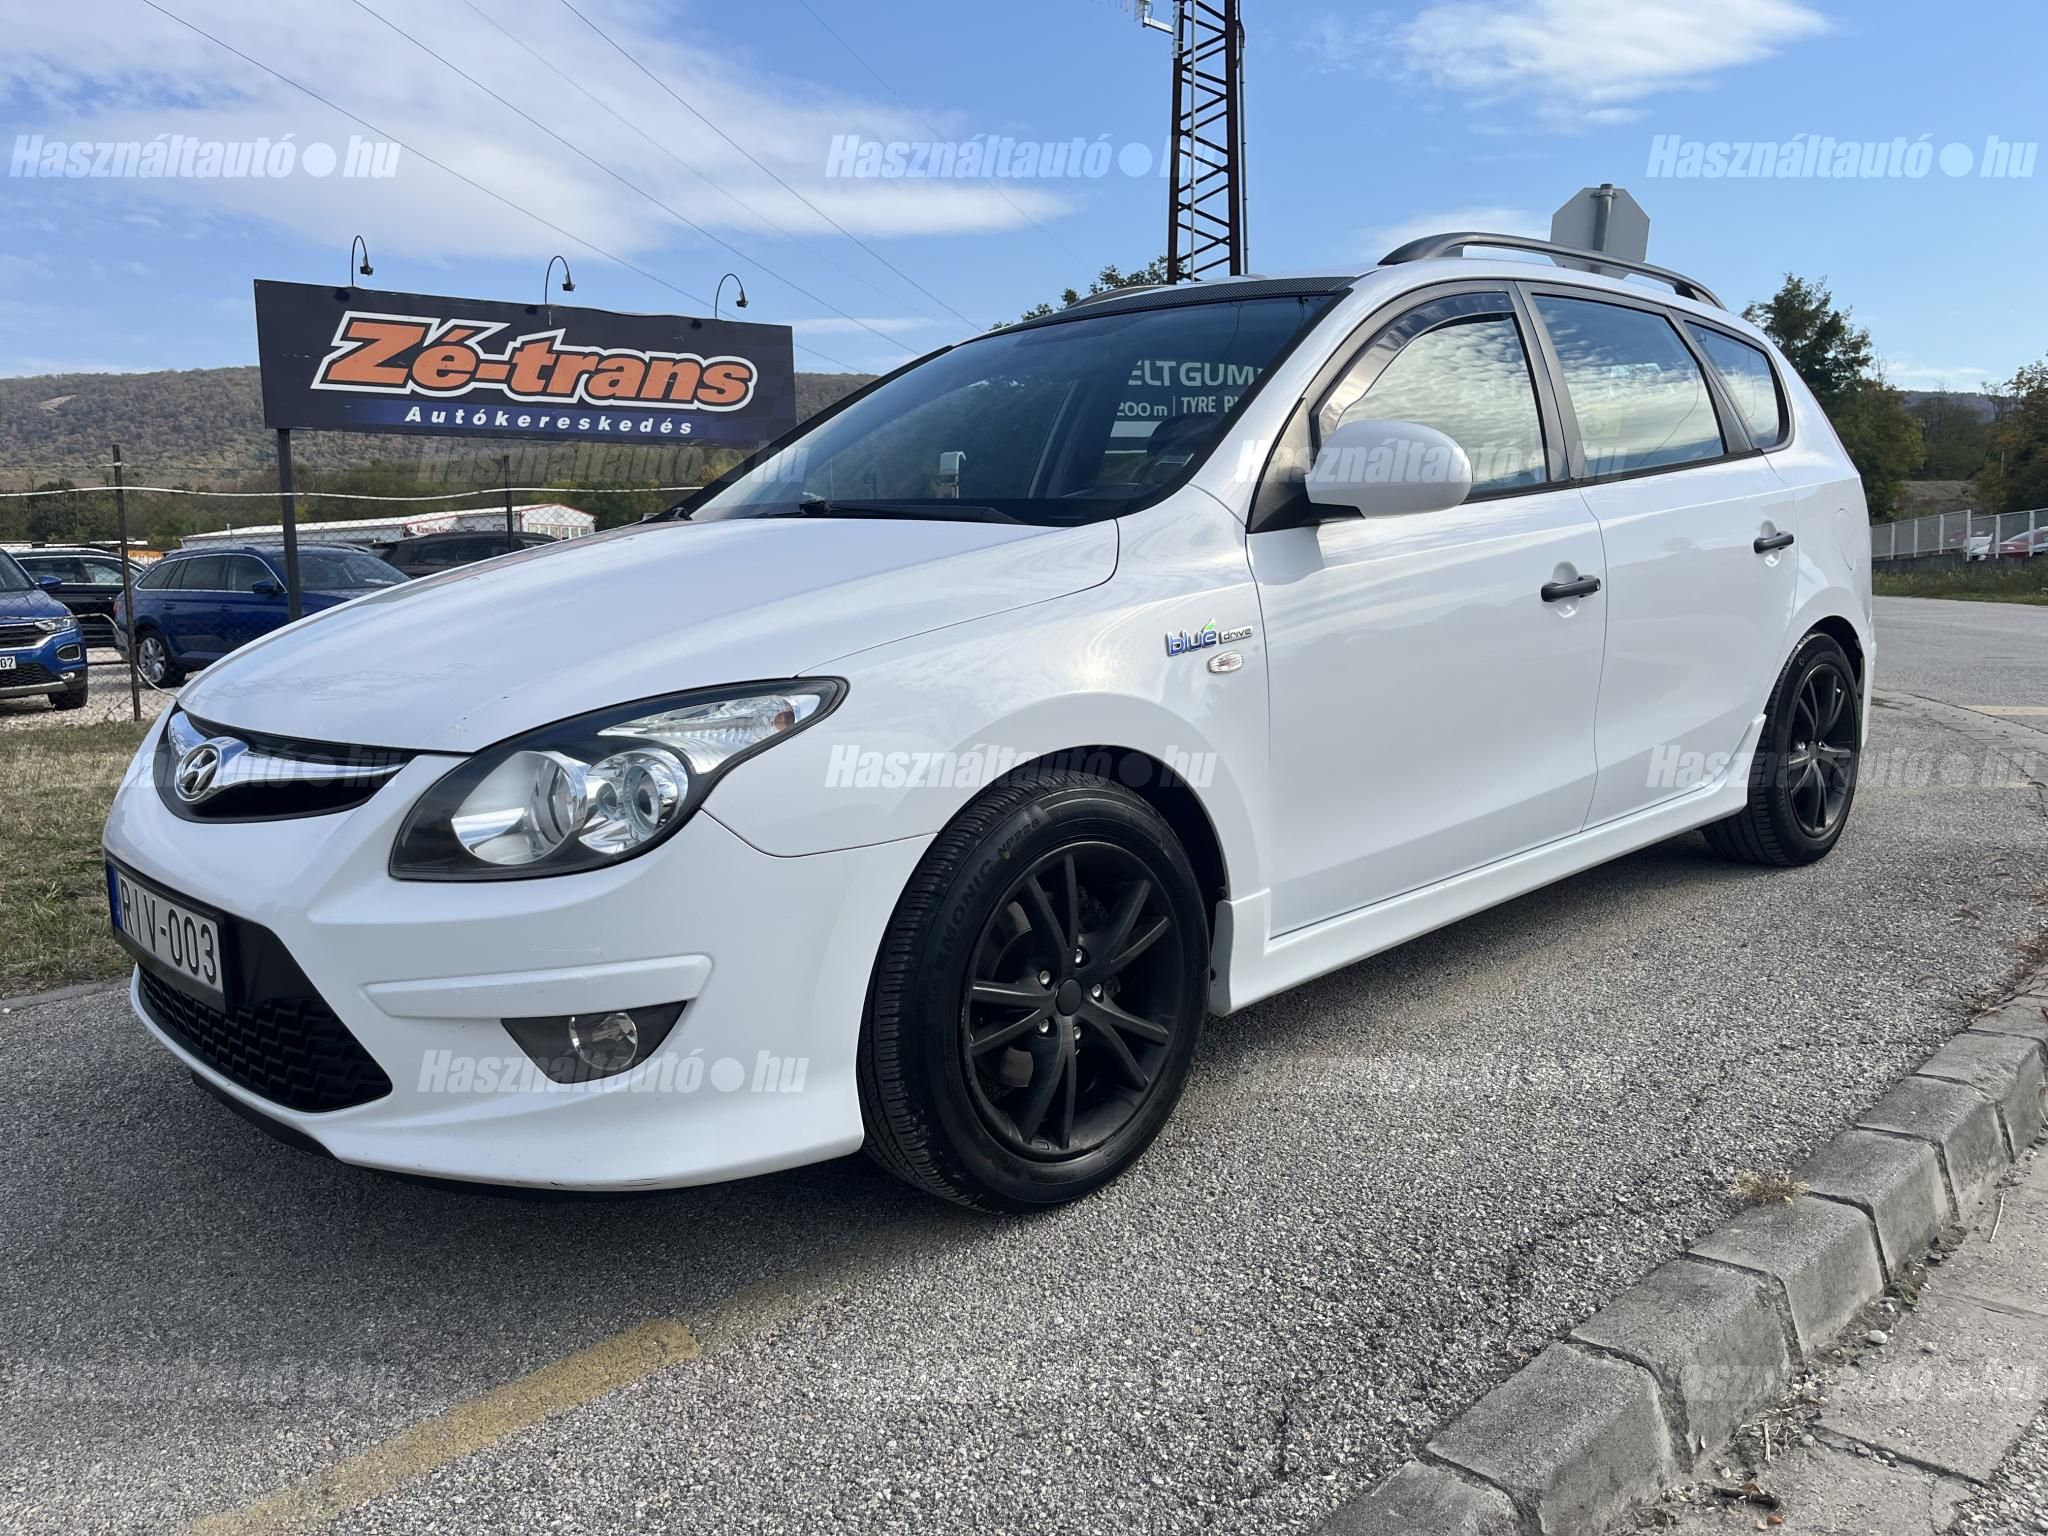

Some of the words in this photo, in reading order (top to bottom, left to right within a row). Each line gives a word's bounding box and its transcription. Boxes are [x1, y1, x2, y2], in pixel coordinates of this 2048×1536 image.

[314, 312, 757, 412] Zé-trans
[1181, 396, 1217, 413] TYRE
[404, 405, 695, 436] Autókereskedés
[1165, 629, 1217, 657] blue
[1223, 627, 1252, 641] drive
[119, 877, 217, 985] RIV-003
